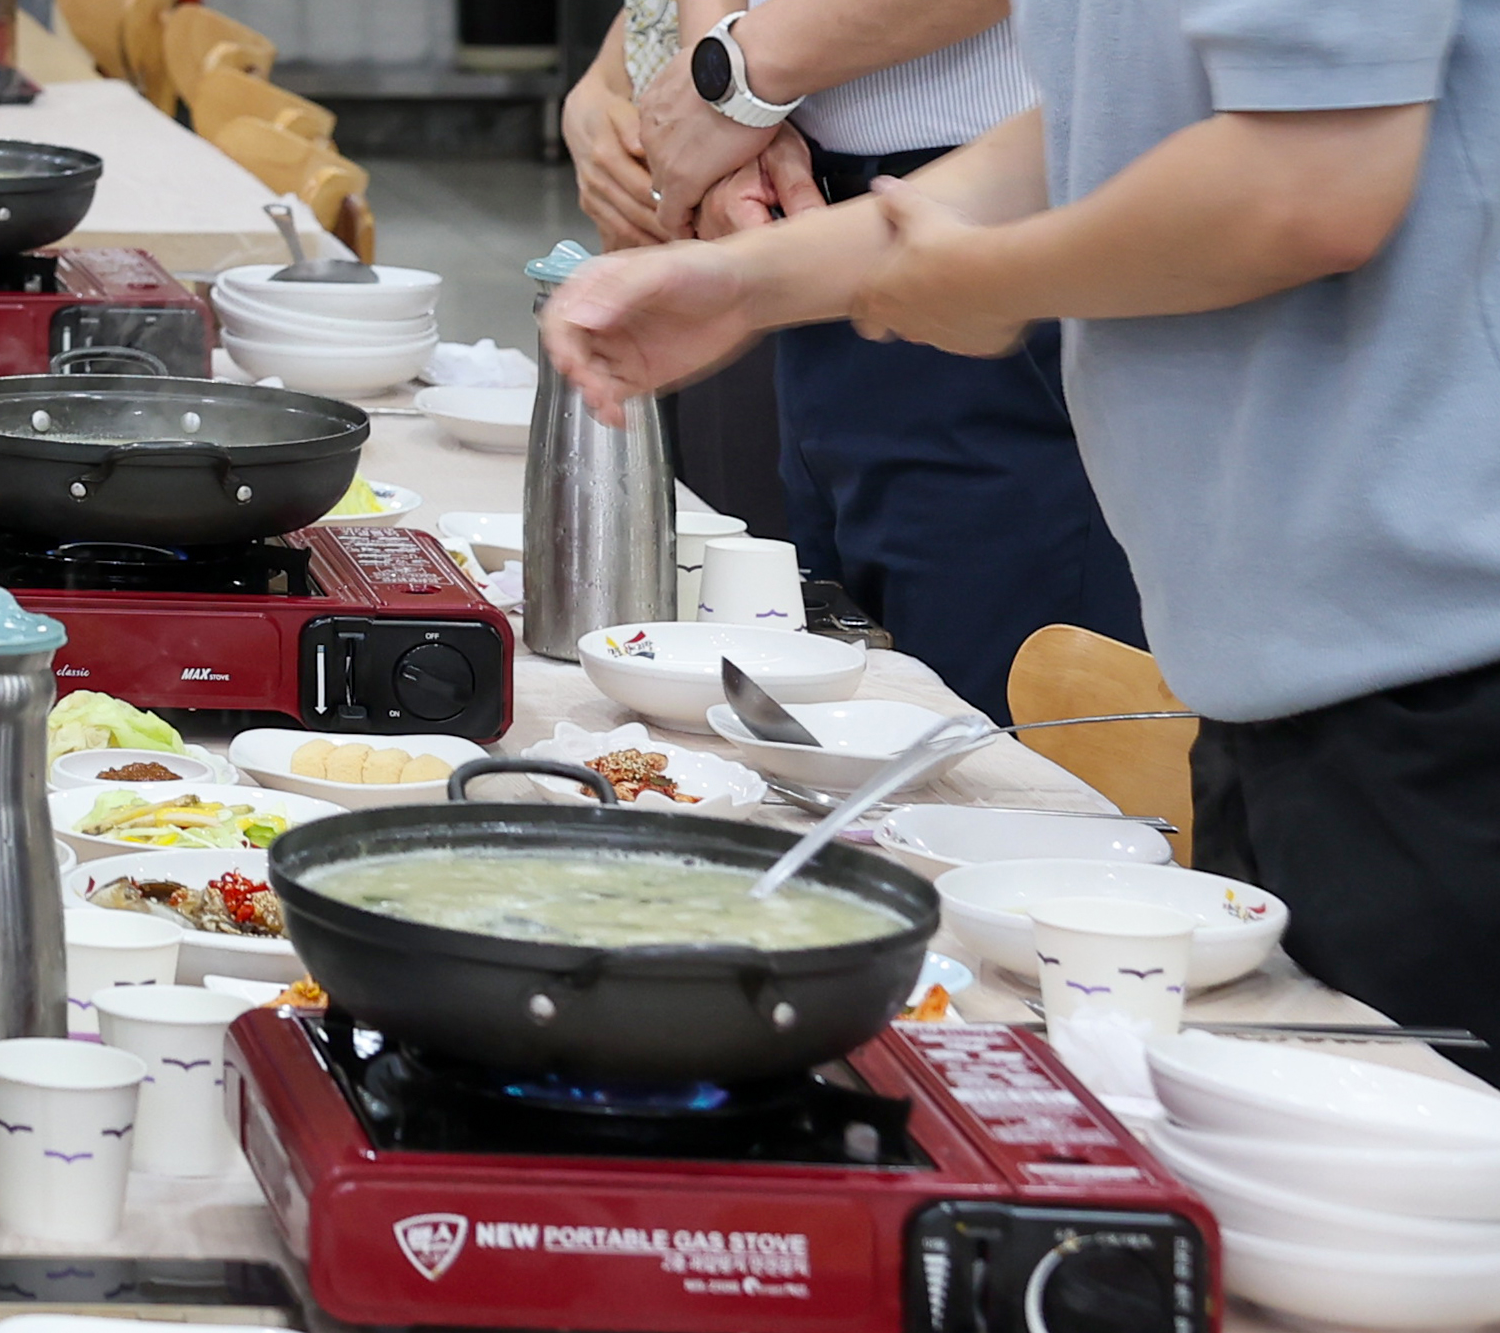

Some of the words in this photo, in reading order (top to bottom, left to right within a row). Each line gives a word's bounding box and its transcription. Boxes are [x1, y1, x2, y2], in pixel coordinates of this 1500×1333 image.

[425, 632, 439, 640] OFF
[56, 664, 90, 677] classic
[389, 709, 400, 718] ON
[476, 1222, 540, 1249] NEW
[544, 1225, 669, 1251] PORTABLE
[673, 1229, 723, 1253] GAS
[728, 1231, 807, 1255] STOVE
